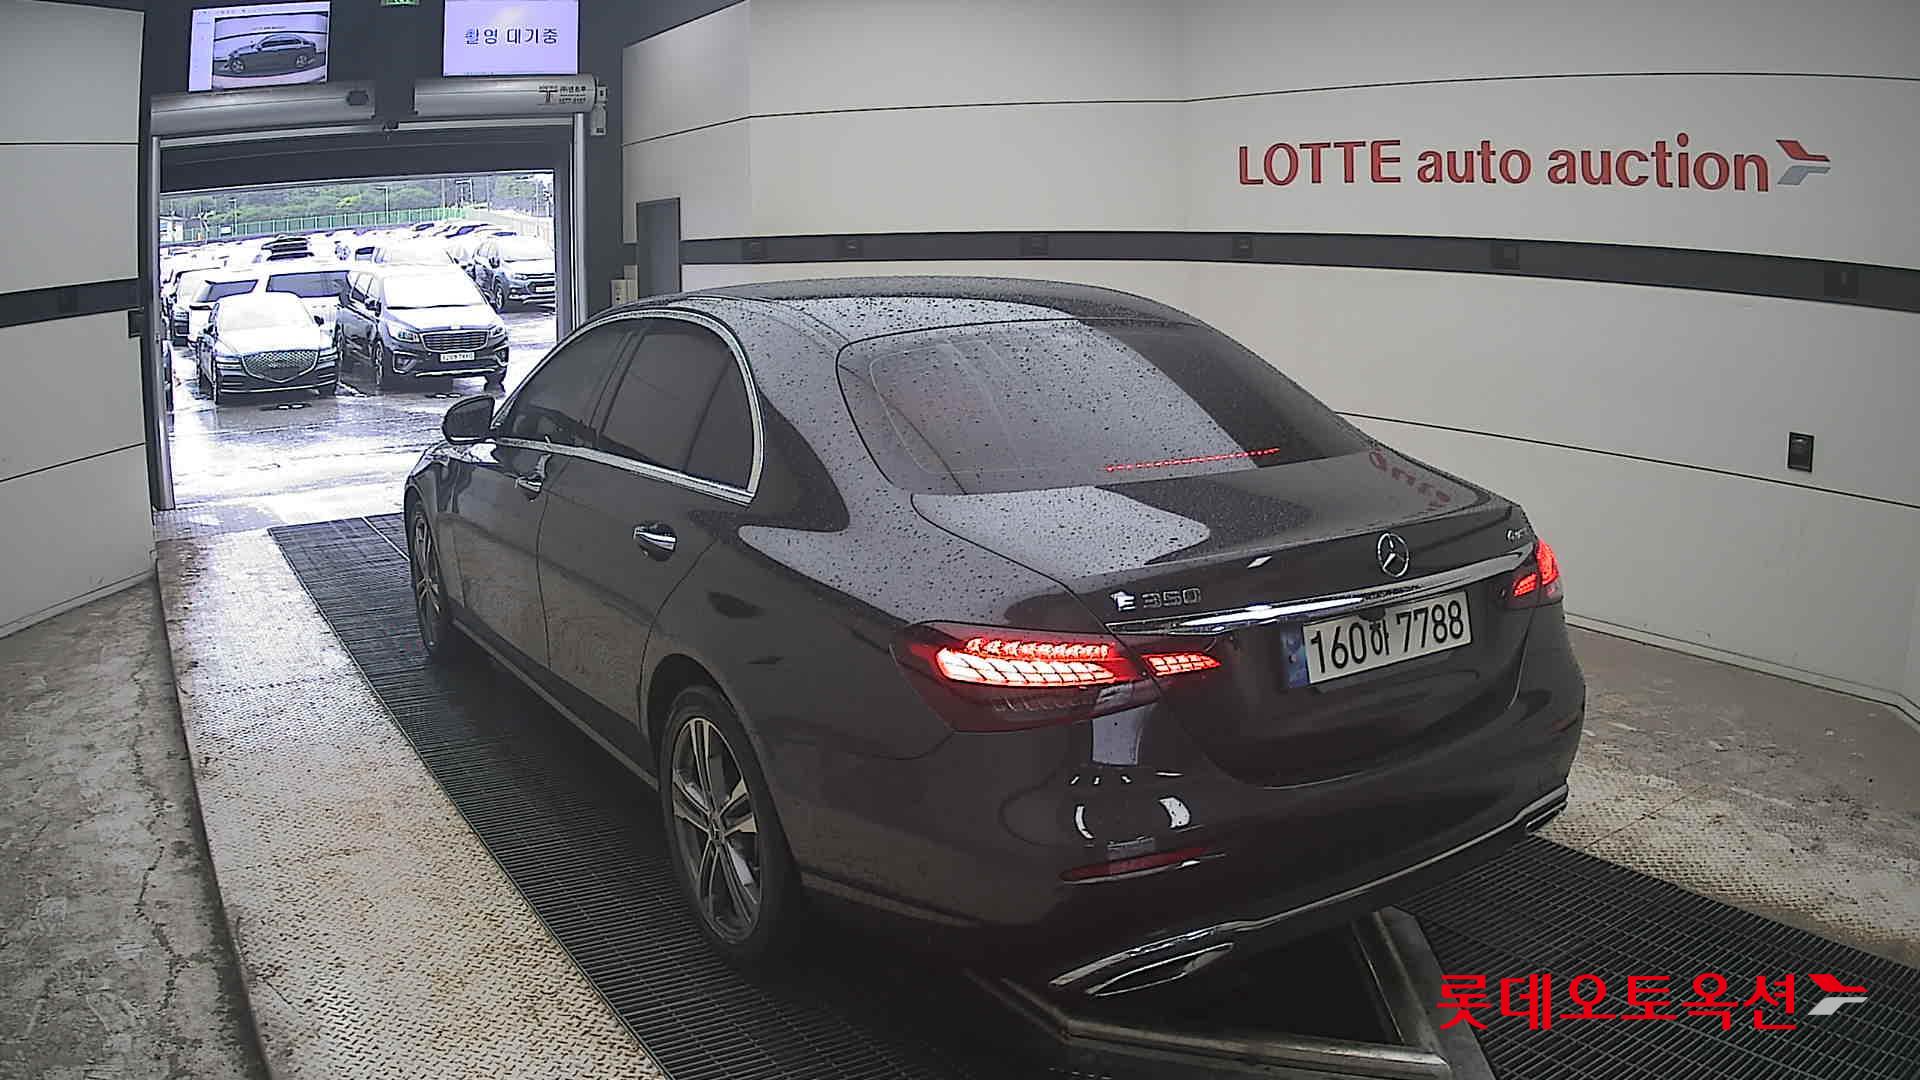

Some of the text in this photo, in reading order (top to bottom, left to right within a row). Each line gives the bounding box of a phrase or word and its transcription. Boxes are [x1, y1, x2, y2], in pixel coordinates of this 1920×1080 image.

[507, 28, 559, 45] 대기중
[1239, 132, 1770, 192] LOTTE auto auction
[1141, 587, 1201, 608] 350
[1311, 600, 1464, 673] 160하 7788
